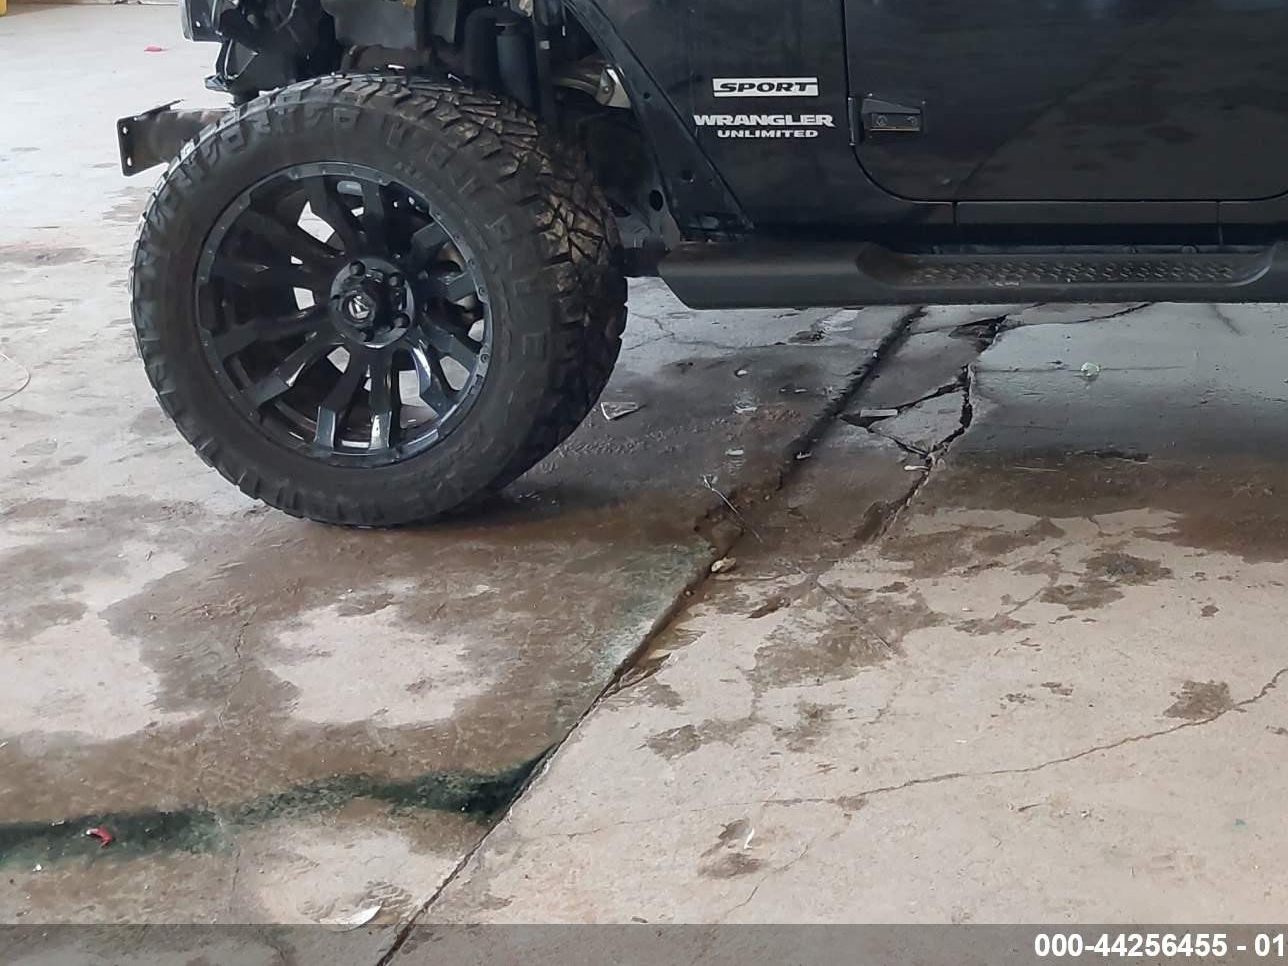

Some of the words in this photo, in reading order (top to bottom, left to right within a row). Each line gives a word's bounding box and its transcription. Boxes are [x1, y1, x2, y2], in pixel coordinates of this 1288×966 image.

[720, 82, 813, 93] SPORT
[693, 114, 835, 127] WRANGLER
[717, 129, 819, 138] UNLIMITED
